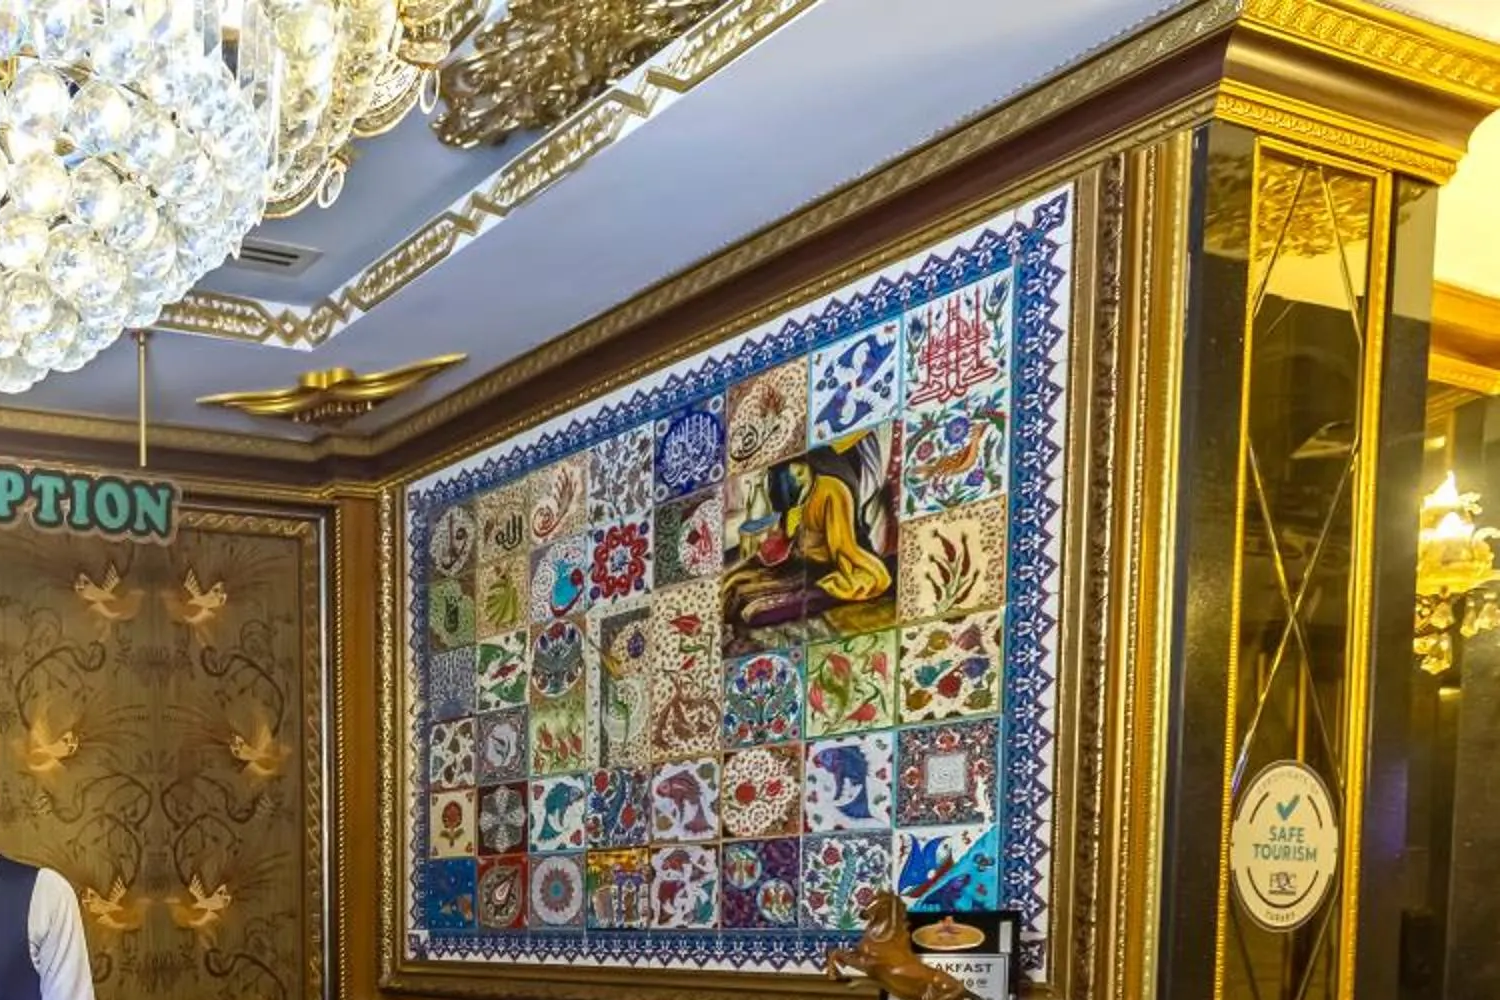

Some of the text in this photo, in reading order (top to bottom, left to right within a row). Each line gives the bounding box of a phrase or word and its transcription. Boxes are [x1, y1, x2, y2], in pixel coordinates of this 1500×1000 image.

[1268, 825, 1306, 843] SAFE
[1251, 843, 1318, 863] TOURISM
[934, 962, 992, 973] AKFAST
